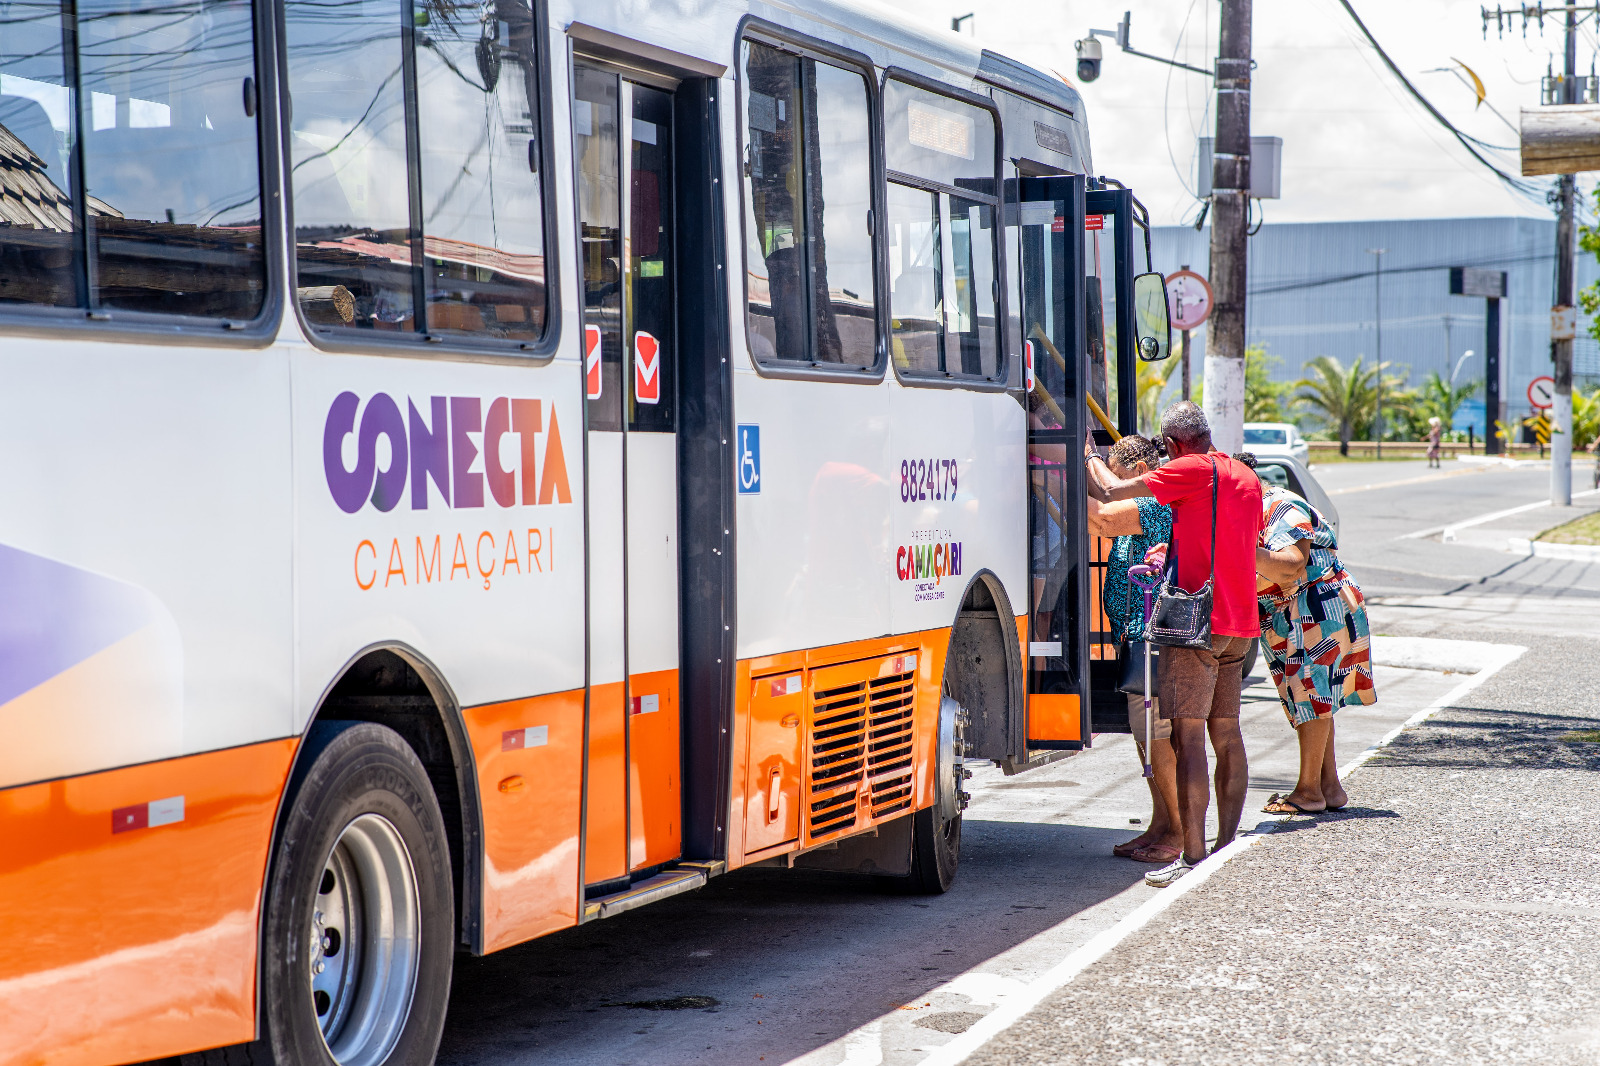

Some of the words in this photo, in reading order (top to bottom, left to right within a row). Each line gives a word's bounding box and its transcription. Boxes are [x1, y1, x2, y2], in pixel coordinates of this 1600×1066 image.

[323, 391, 573, 514] CONECTA
[900, 458, 958, 503] 8824179
[911, 529, 952, 541] PREFEITURA
[354, 527, 553, 591] CAMAÇARI
[896, 542, 962, 585] CAMAÇARI
